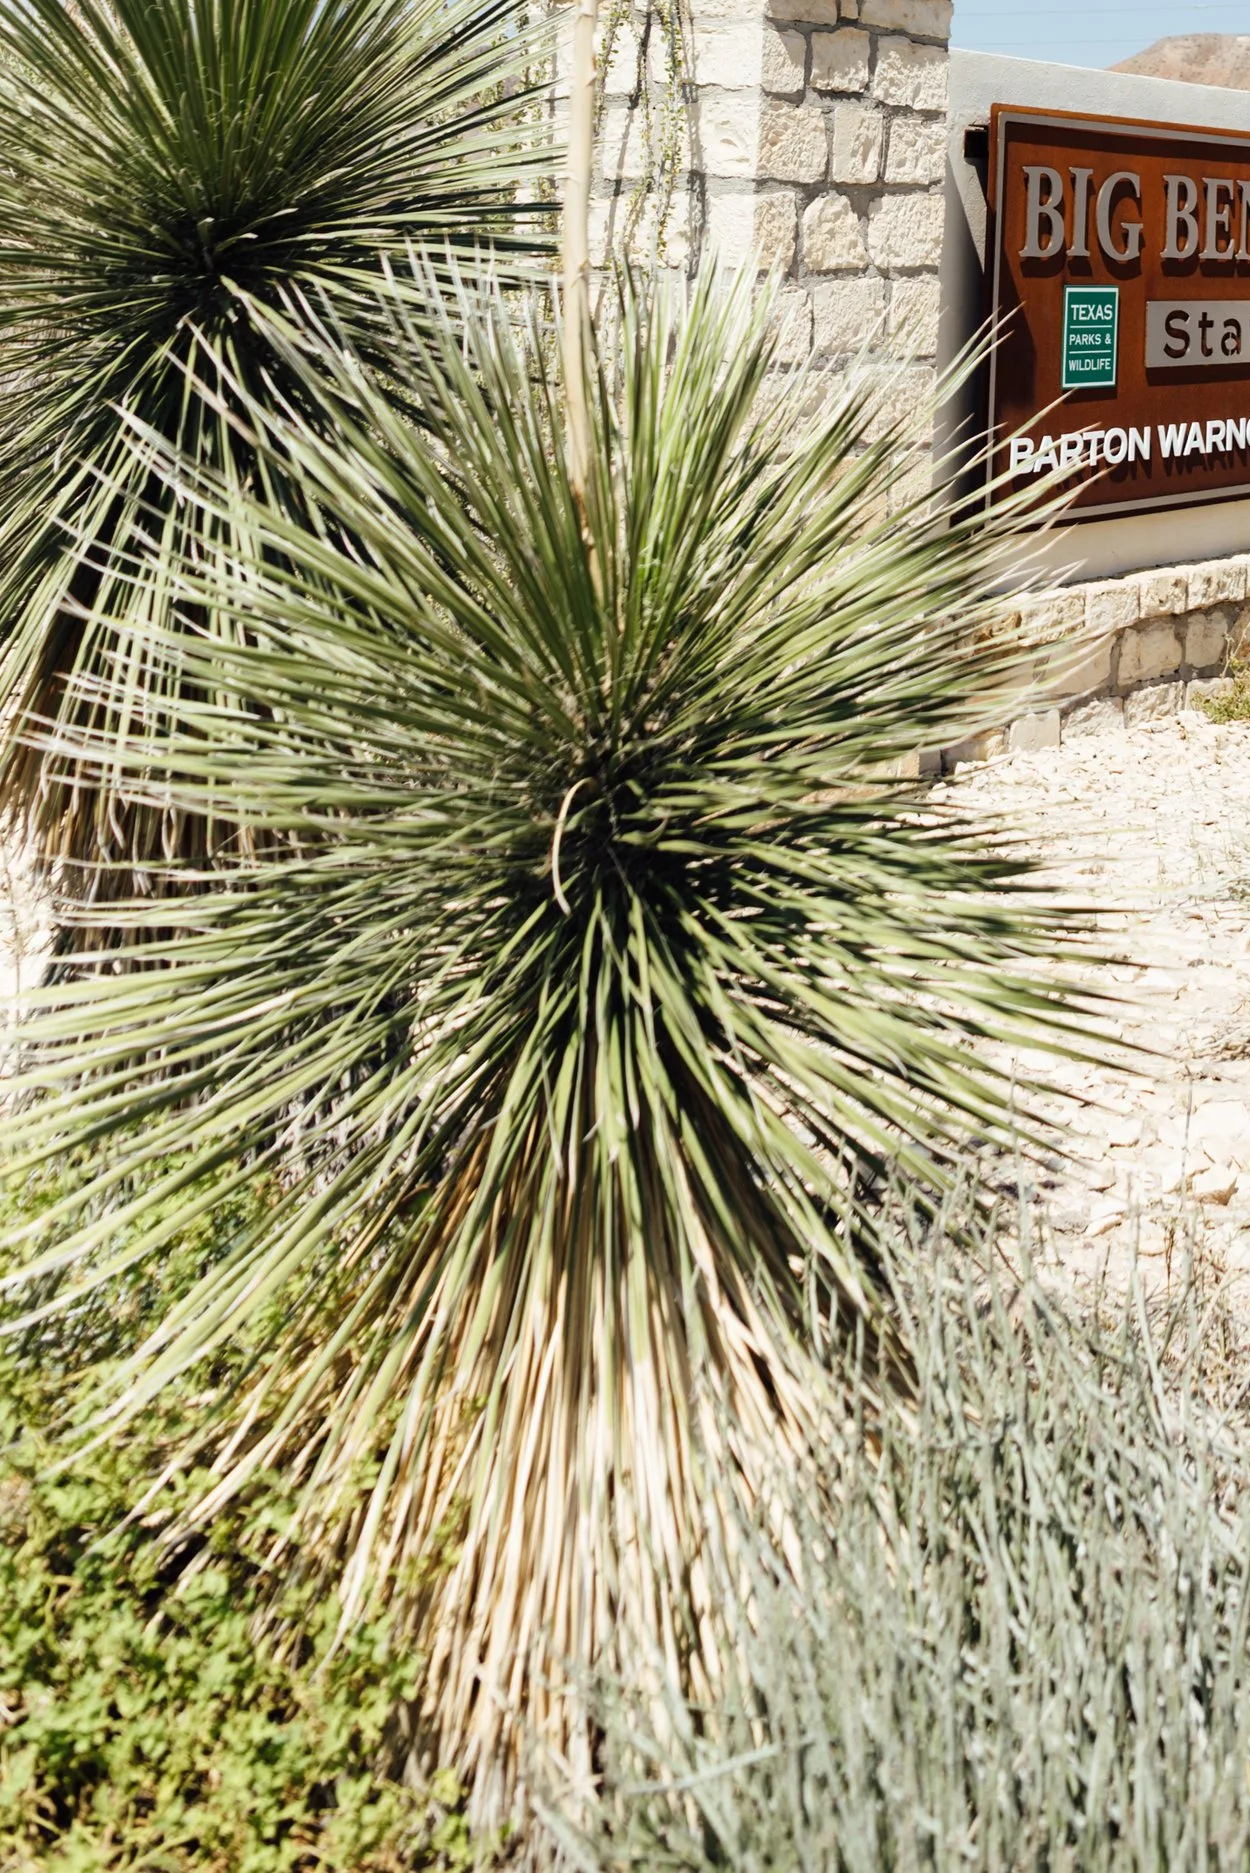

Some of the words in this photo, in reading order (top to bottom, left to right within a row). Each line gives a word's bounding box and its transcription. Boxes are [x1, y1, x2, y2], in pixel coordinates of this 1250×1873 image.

[1019, 165, 1144, 261] BIG
[1070, 304, 1113, 321] TEXAS
[1068, 333, 1102, 346] PARKS
[1104, 332, 1112, 345] &
[1068, 358, 1112, 372] WILDLIFE
[1009, 426, 1151, 474] BARTON
